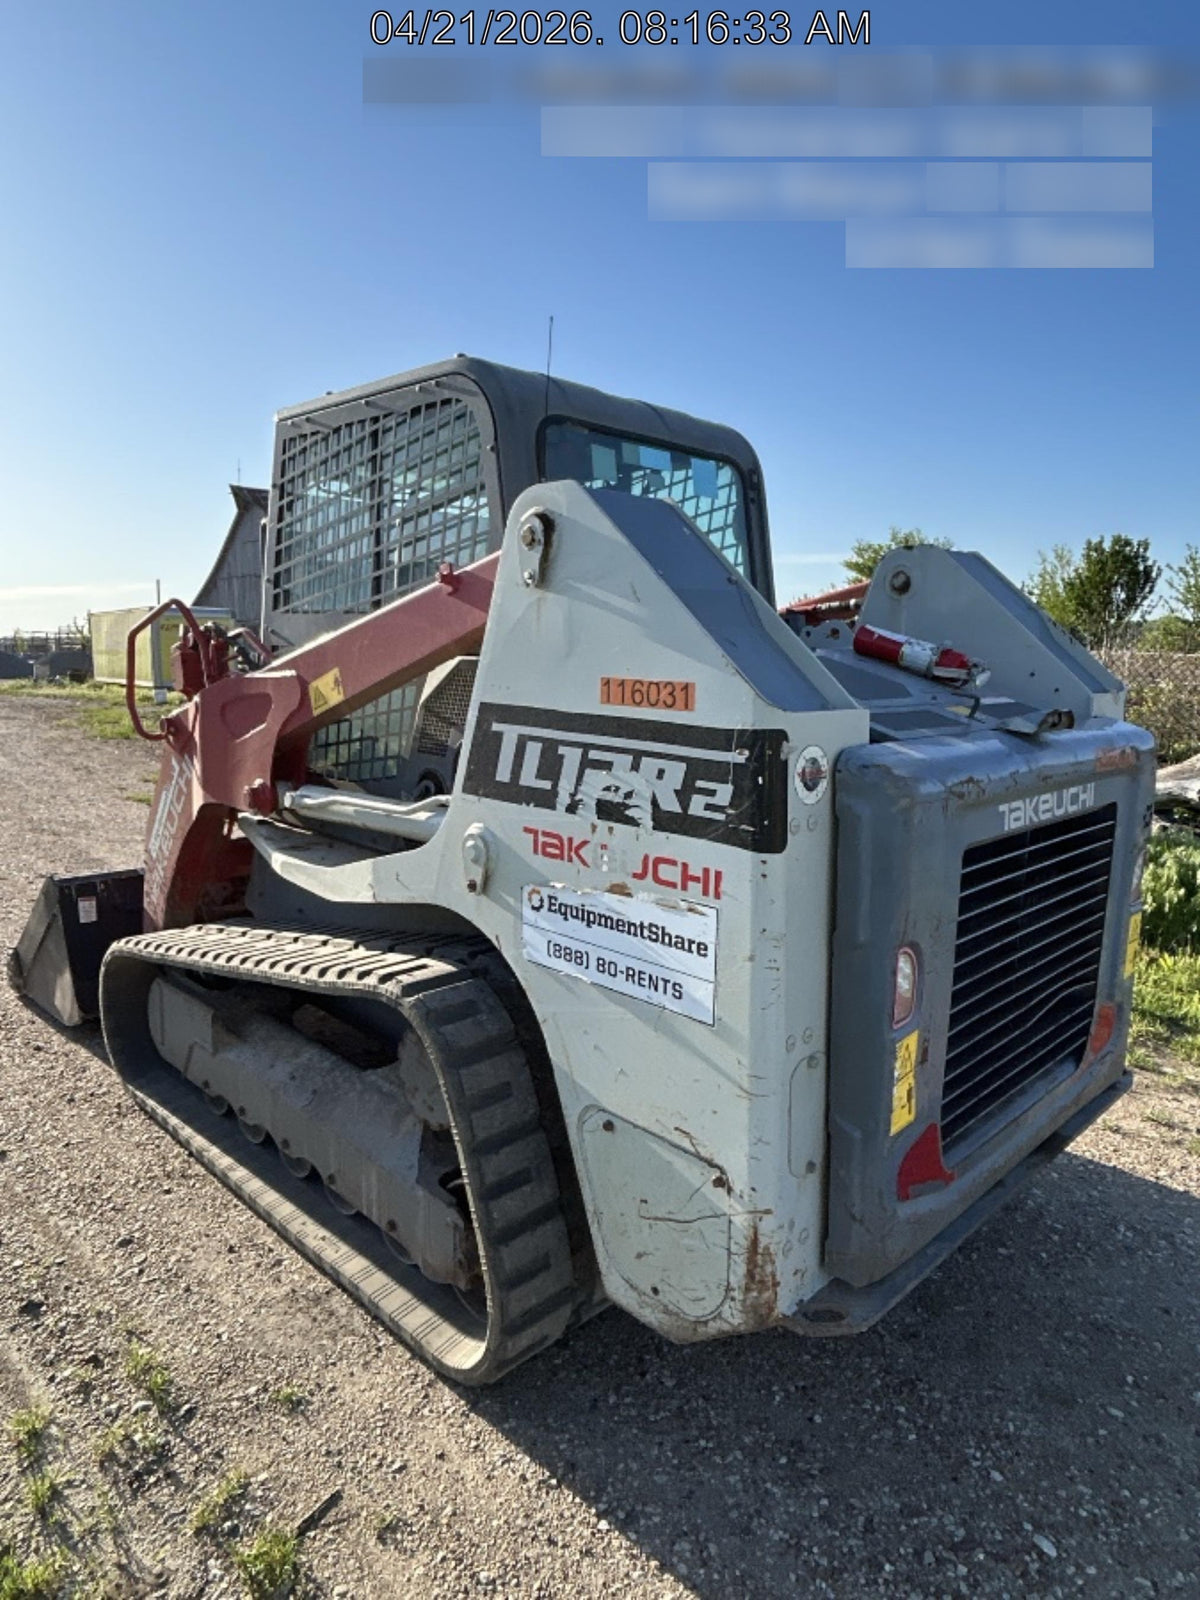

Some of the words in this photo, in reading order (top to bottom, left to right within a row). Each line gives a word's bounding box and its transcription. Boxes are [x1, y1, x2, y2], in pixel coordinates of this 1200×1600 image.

[602, 678, 692, 710] 116031
[523, 826, 723, 900] TAKUCHI
[546, 895, 708, 958] EquipmentShare
[547, 940, 590, 970] (888)
[596, 957, 683, 1000] 80-RENTS
